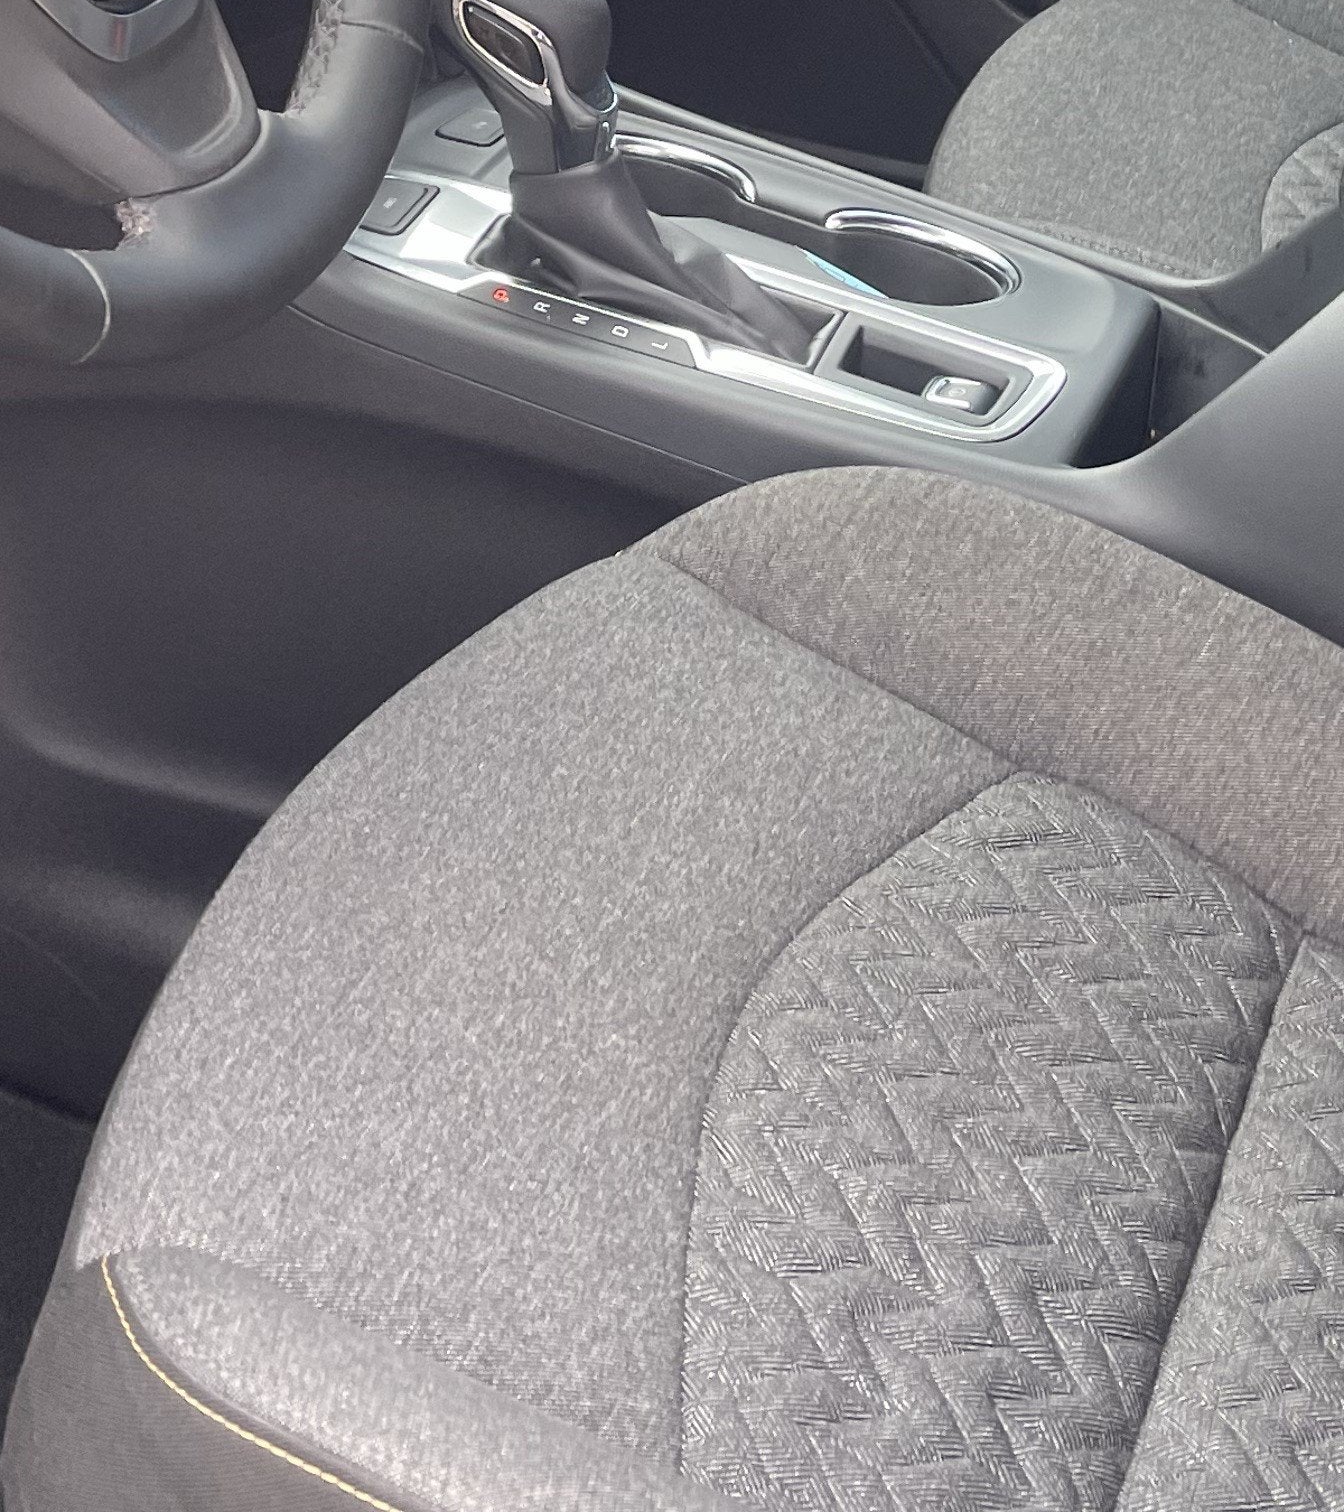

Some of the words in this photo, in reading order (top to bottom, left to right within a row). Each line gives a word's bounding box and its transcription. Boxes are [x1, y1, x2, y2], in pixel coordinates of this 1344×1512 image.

[533, 301, 551, 314] R
[572, 313, 590, 326] N
[611, 324, 629, 338] D
[651, 341, 669, 351] L
